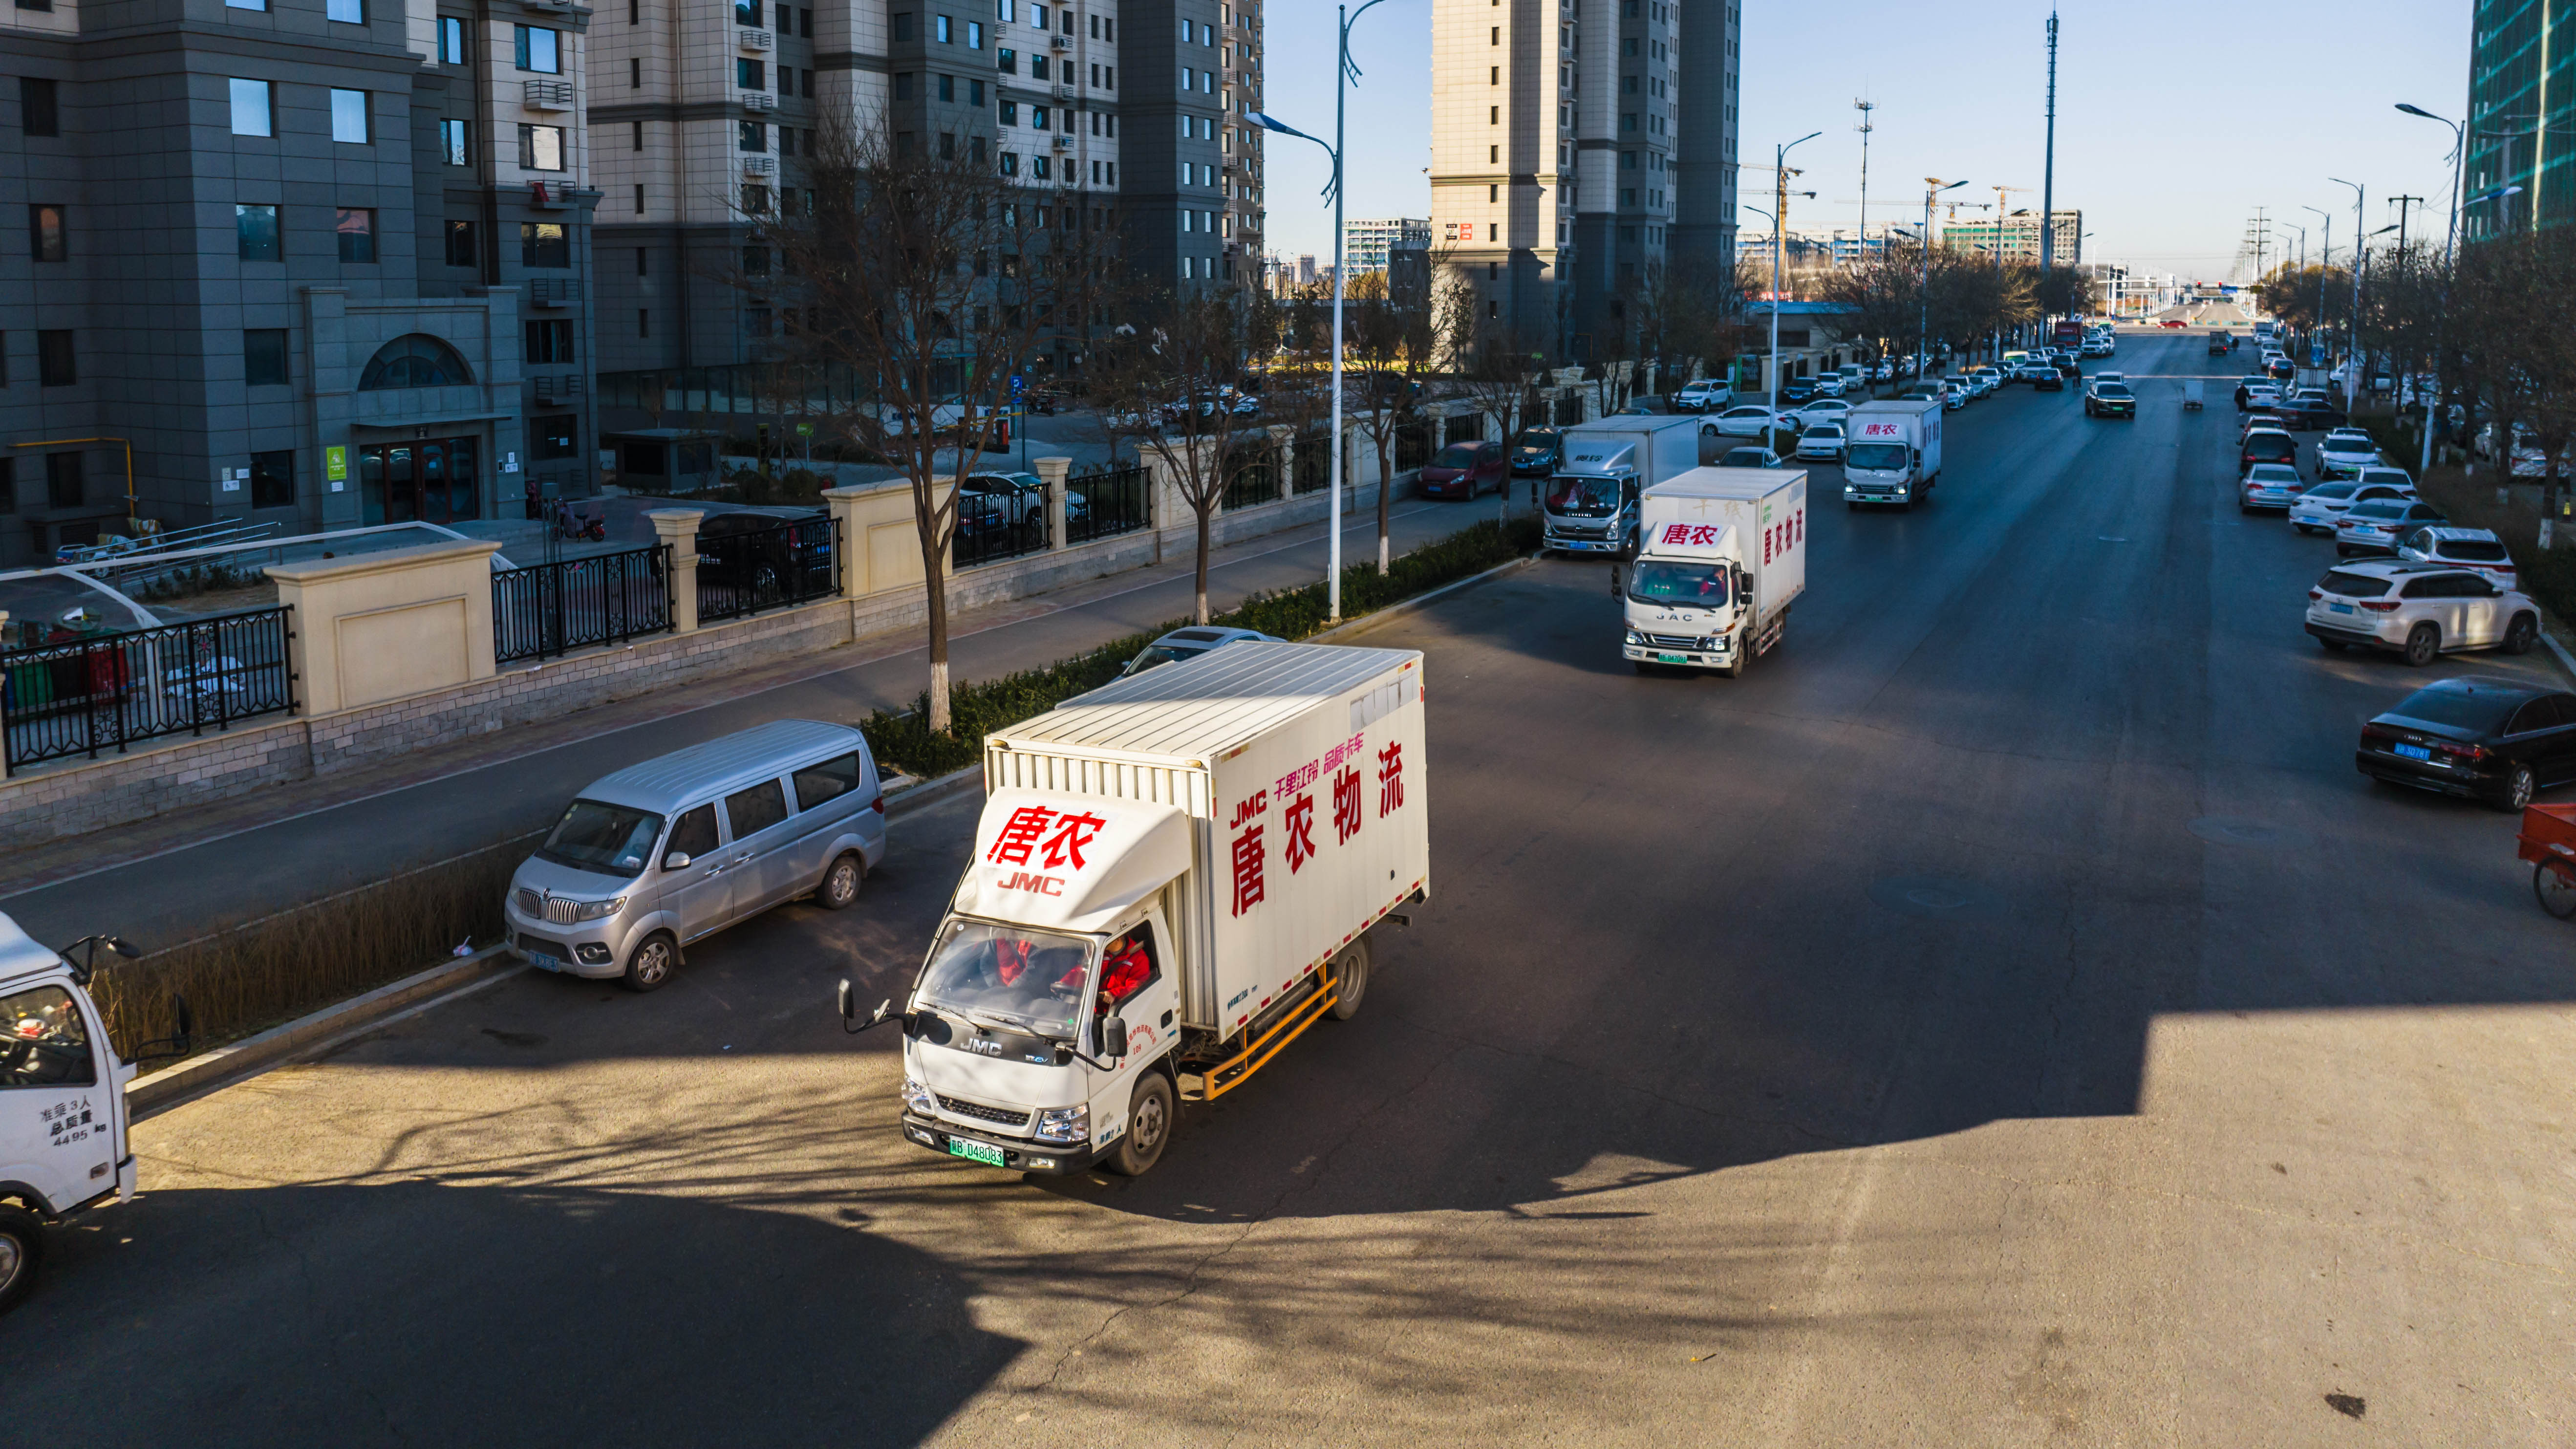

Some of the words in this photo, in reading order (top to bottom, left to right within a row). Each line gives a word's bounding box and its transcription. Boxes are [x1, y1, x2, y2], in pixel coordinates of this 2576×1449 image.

[1866, 424, 1897, 435] 唐农
[1662, 524, 1718, 545] 唐农
[1764, 507, 1802, 567] 唐农物流
[1656, 612, 1693, 622] JAC
[1323, 732, 1364, 775] 品质卡车
[1274, 759, 1319, 801] 千里江铃
[1230, 789, 1267, 830] JMC
[987, 806, 1107, 871] 唐农
[1232, 740, 1404, 919] 唐农物流
[997, 872, 1065, 897] JMC
[960, 1038, 1002, 1056] JMC
[1133, 1043, 1141, 1055] 109
[50, 1109, 92, 1136] 总质量
[53, 1130, 88, 1146] 4495
[94, 1124, 107, 1133] kg
[967, 1143, 1002, 1164] D48083
